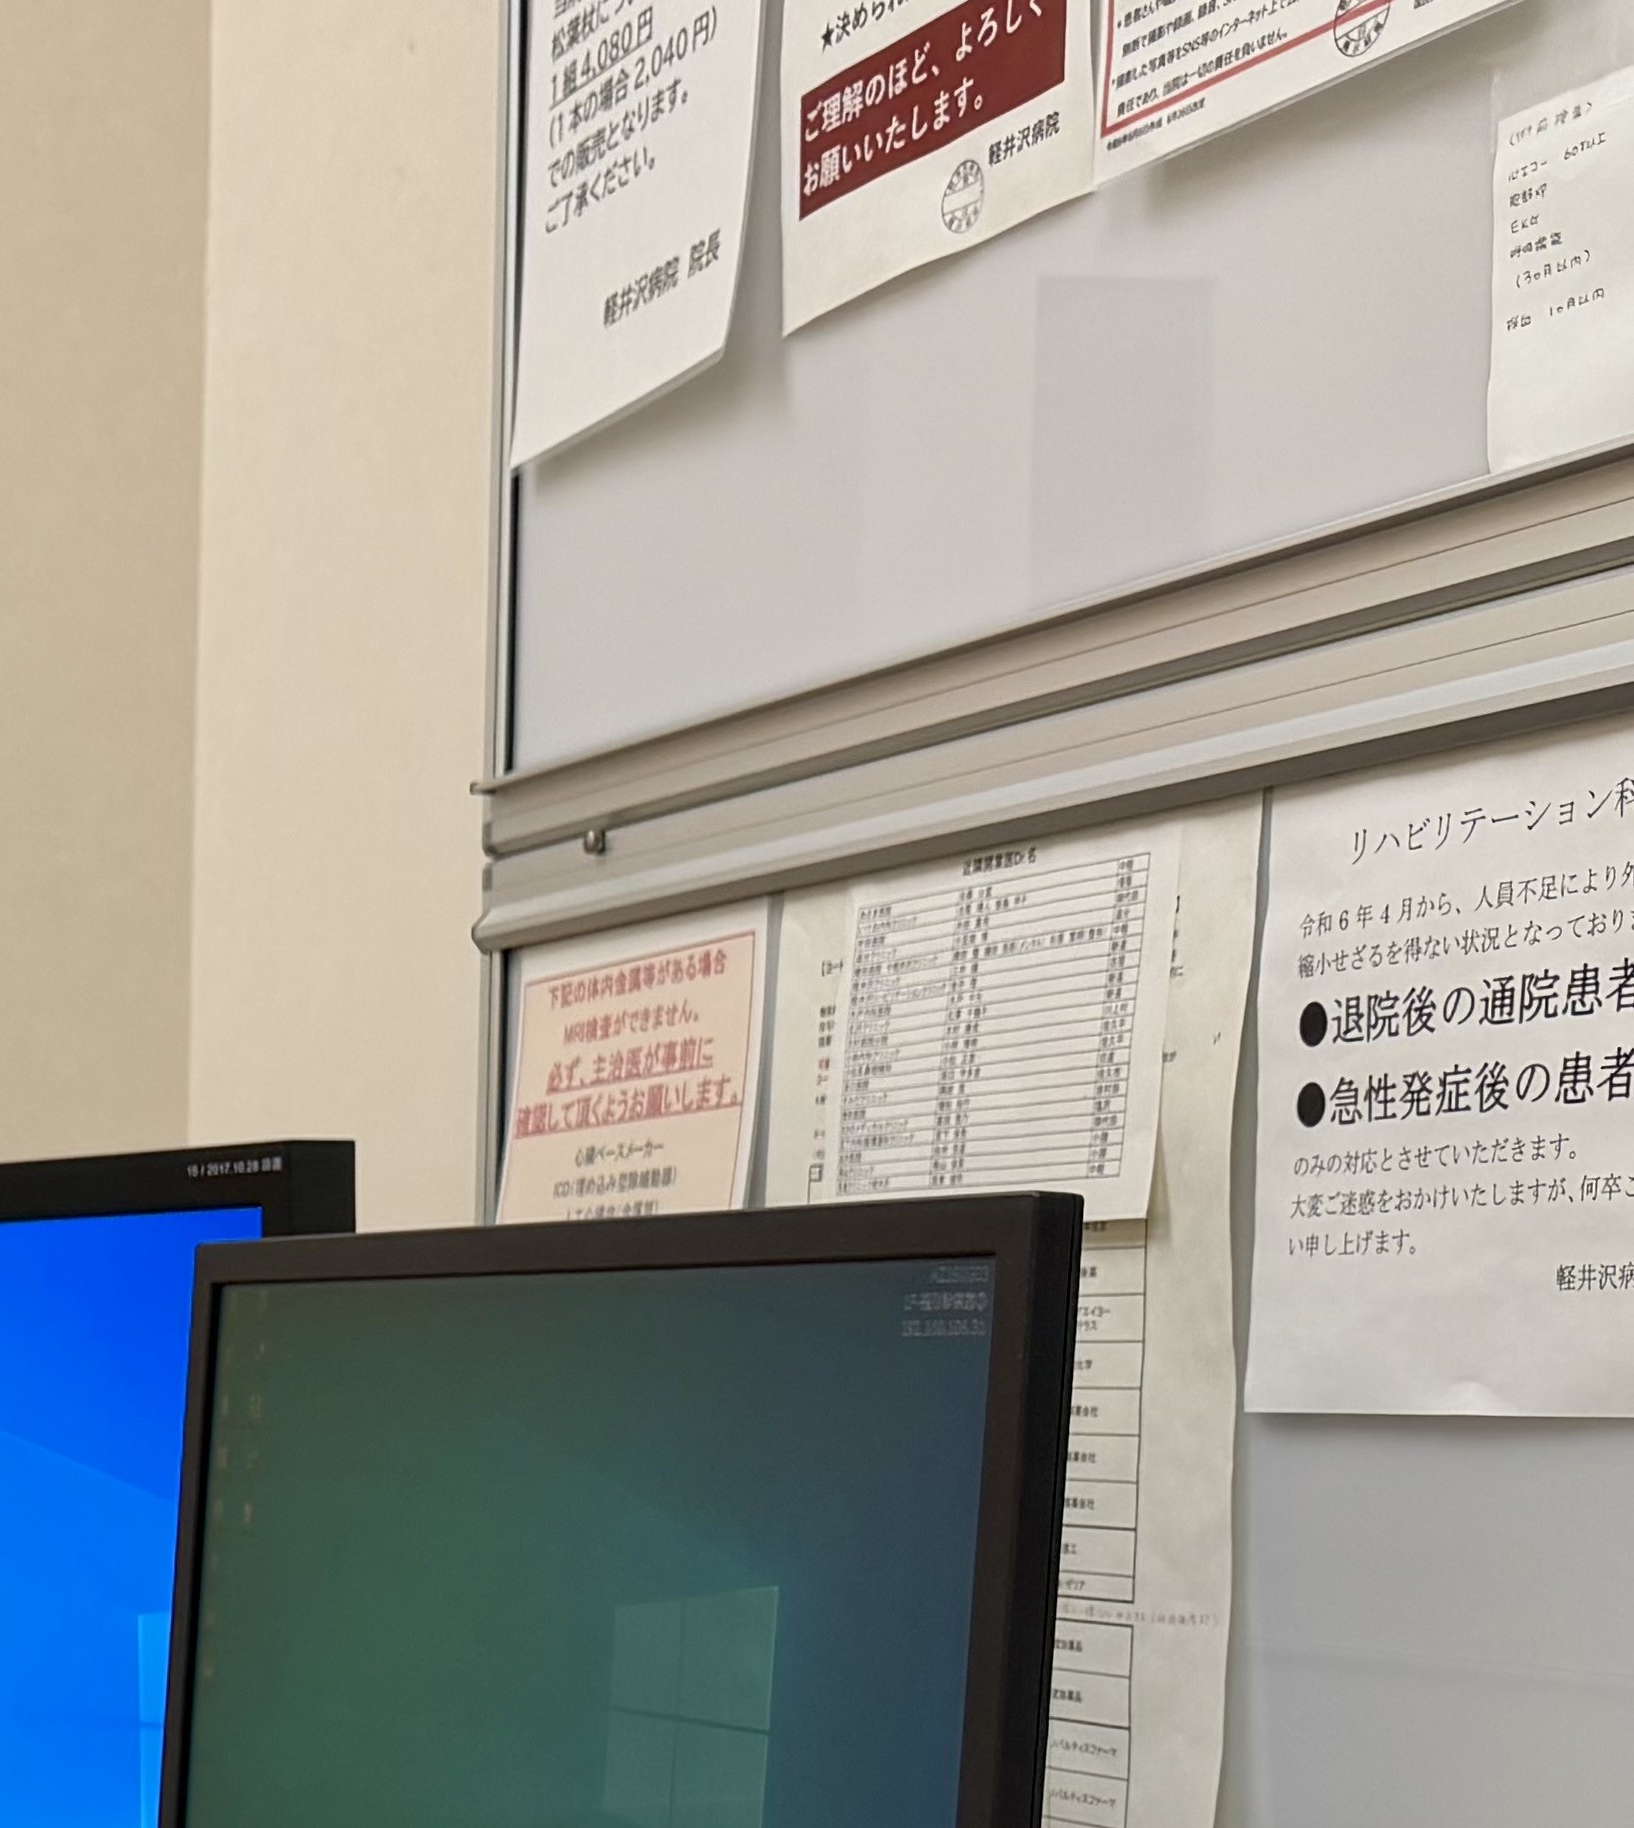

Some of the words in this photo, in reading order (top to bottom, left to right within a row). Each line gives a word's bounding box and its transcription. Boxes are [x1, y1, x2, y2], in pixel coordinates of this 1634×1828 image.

[547, 78, 689, 188] での販売となります。
[804, 77, 984, 197] お願いいたします。
[988, 111, 1061, 167] 軽井沢病院
[545, 146, 656, 234] ご了承ください。
[603, 255, 681, 329] 軽井沢病院
[687, 226, 722, 280] 院長
[1296, 907, 1634, 980] 縮小せざるを得ない状況となっており
[548, 948, 728, 1011] 下記の体内金属等がある場合
[546, 1037, 714, 1094] 必ず、主治医が事前に
[1292, 1132, 1579, 1177] のみの対応とさせていただきます。
[1288, 1230, 1419, 1259] い申し上げます。
